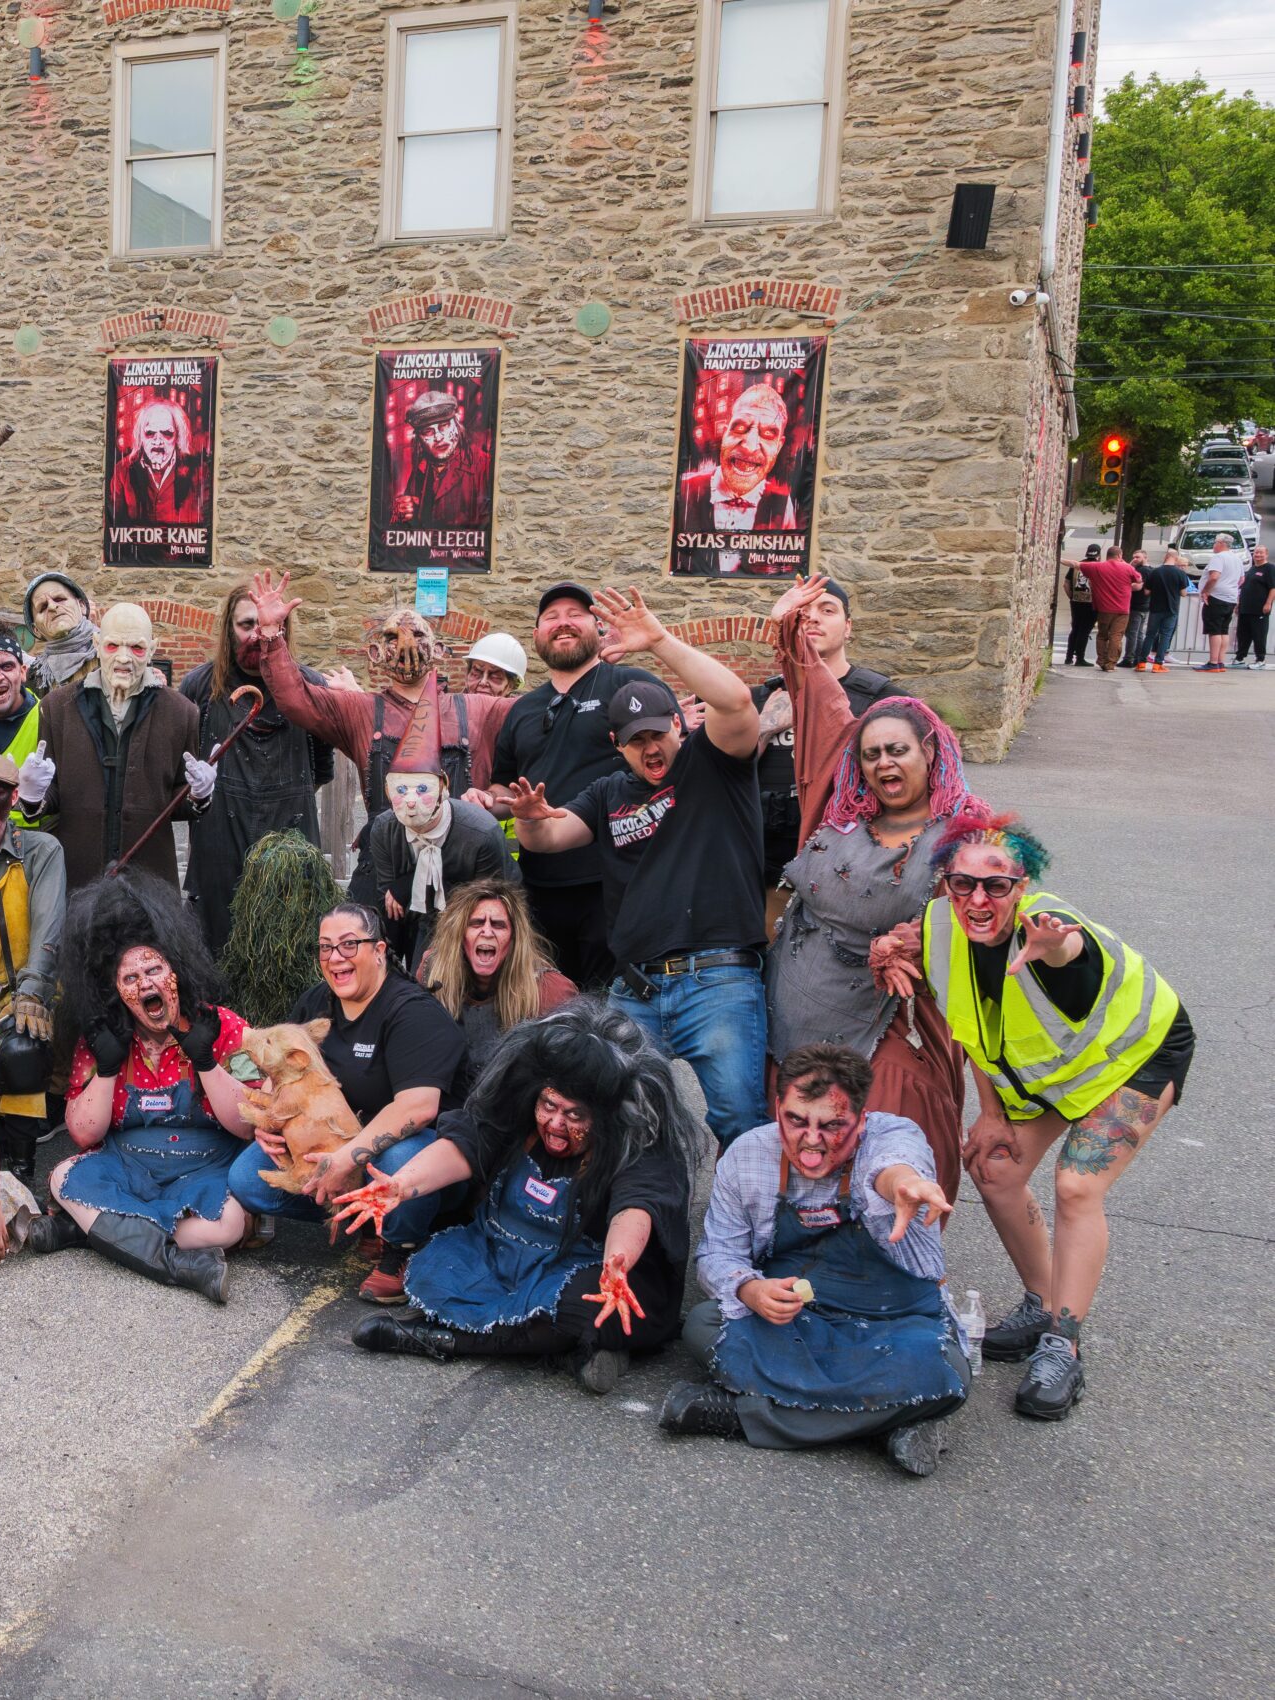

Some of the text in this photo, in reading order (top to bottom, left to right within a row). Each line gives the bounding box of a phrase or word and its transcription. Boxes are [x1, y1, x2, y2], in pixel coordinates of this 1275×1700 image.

[705, 342, 806, 359] LINCOLN MILL
[124, 361, 201, 376] LINCOLN MILL
[394, 352, 482, 369] LINCOLN MILL
[703, 357, 806, 370] HAUNTED HOUSE
[122, 375, 202, 386] HAUNTED HOUSE
[393, 367, 482, 379] HAUNTED HOUSE
[109, 527, 207, 544] VIKTOR KANE
[386, 530, 485, 547] EDWIN LEECH
[676, 533, 805, 551] SYLAS GRIMSHAW
[609, 809, 654, 836] INCOLN
